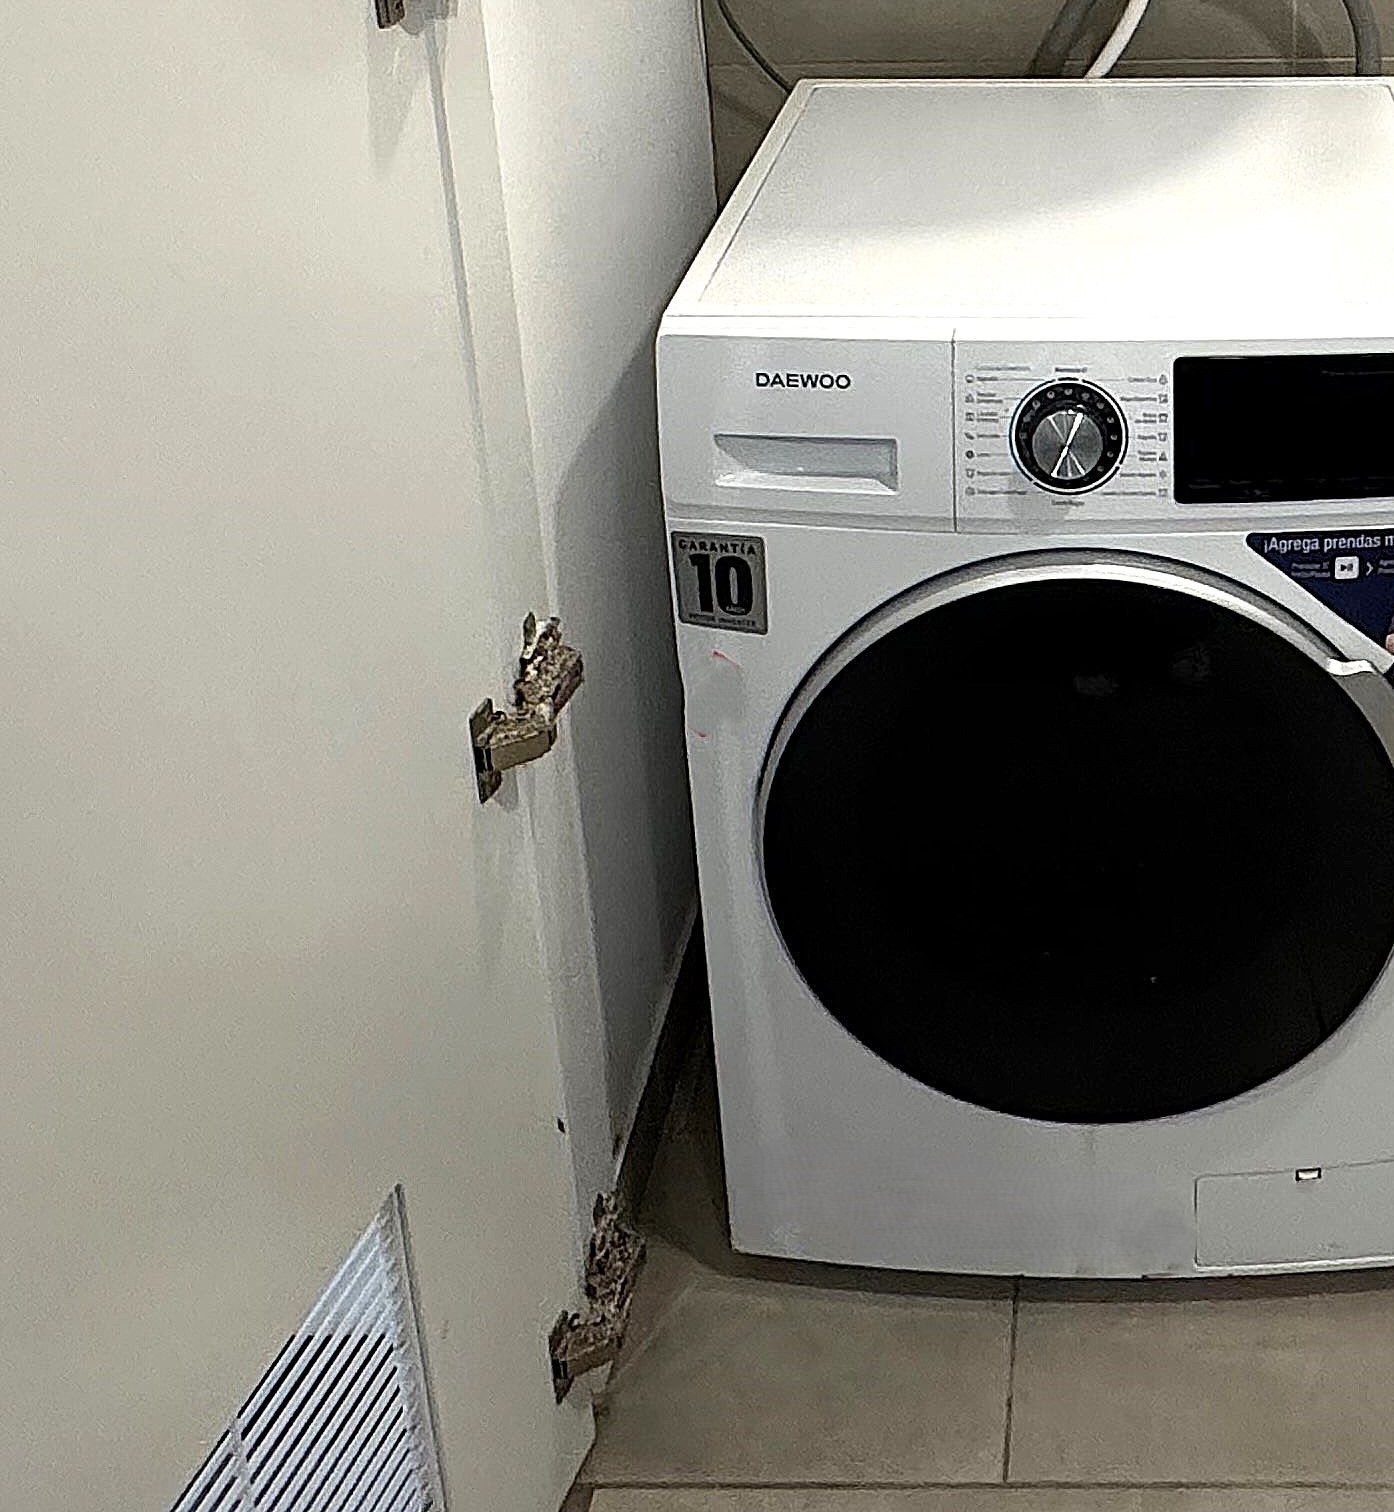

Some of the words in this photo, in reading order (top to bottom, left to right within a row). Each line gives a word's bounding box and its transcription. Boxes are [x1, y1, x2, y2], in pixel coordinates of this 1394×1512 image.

[755, 372, 851, 389] DAEWOO
[1323, 533, 1381, 552] prendas
[688, 553, 753, 616] 10
